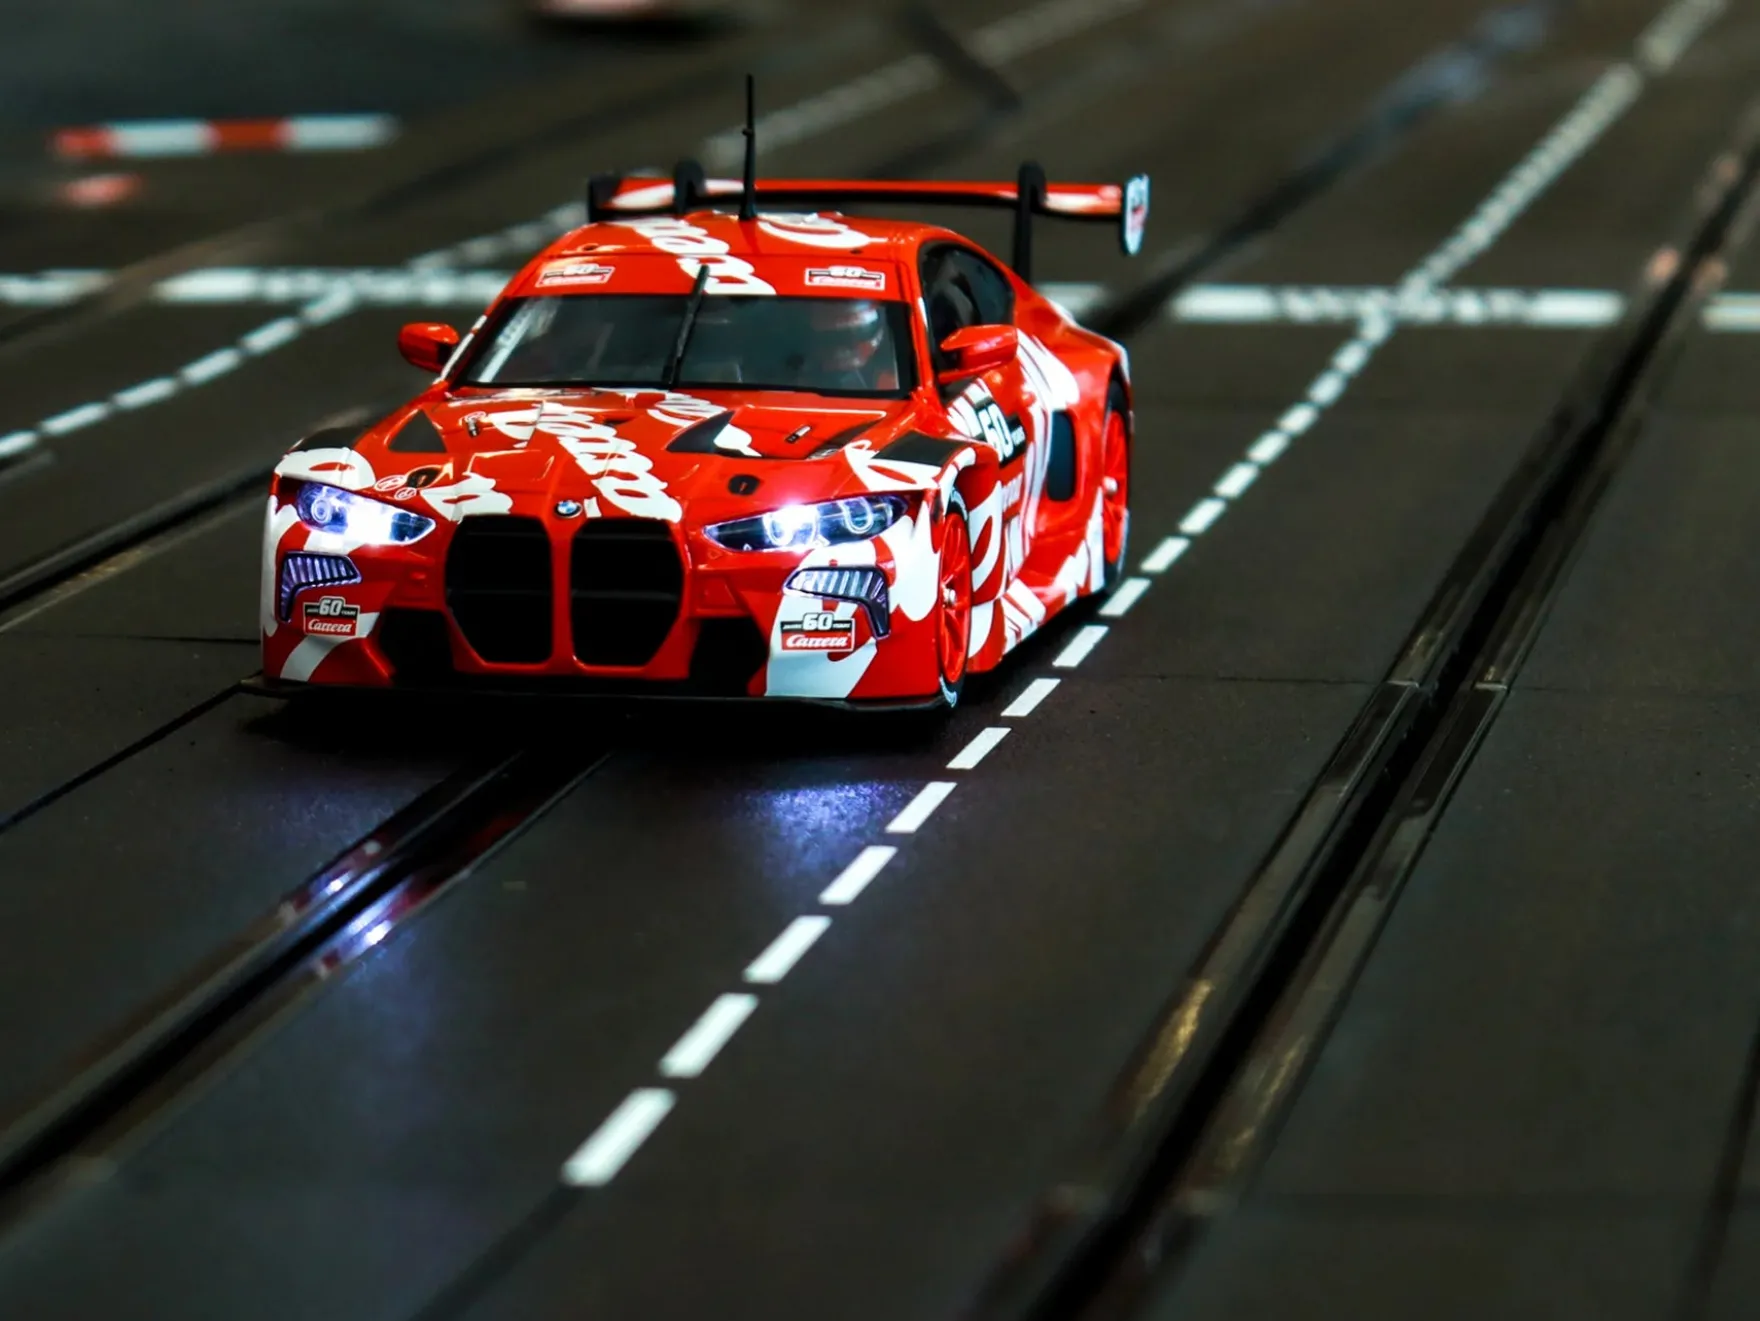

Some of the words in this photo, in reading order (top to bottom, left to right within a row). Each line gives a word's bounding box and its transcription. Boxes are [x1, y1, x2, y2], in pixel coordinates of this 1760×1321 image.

[319, 599, 342, 616] 60
[308, 619, 352, 633] Carrera
[803, 614, 833, 631] 60
[786, 634, 848, 648] Carrera
